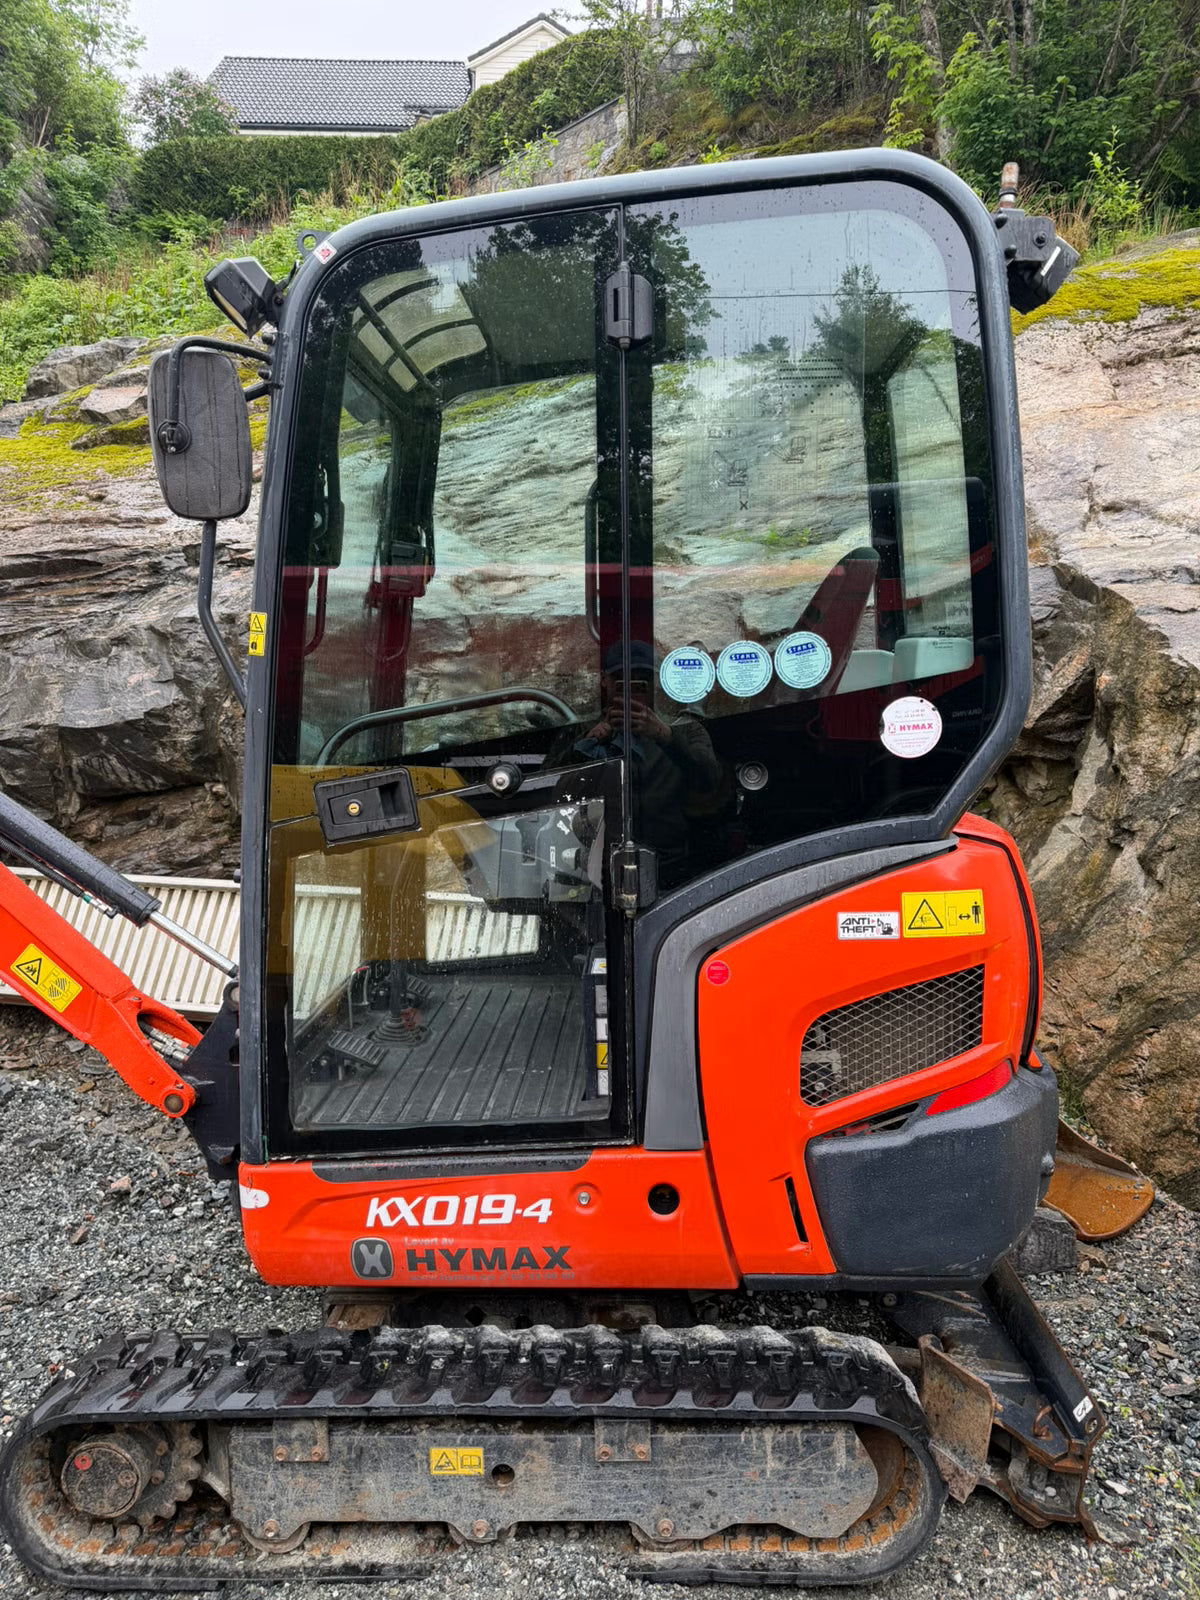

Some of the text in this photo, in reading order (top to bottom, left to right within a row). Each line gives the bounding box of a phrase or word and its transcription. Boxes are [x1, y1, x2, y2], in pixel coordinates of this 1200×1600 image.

[899, 722, 934, 732] HYMAX
[841, 917, 871, 925] ANTI
[840, 925, 877, 934] THEFT
[365, 1193, 553, 1228] KX019-4
[404, 1236, 454, 1246] Levert av
[406, 1246, 572, 1271] HYMAX
